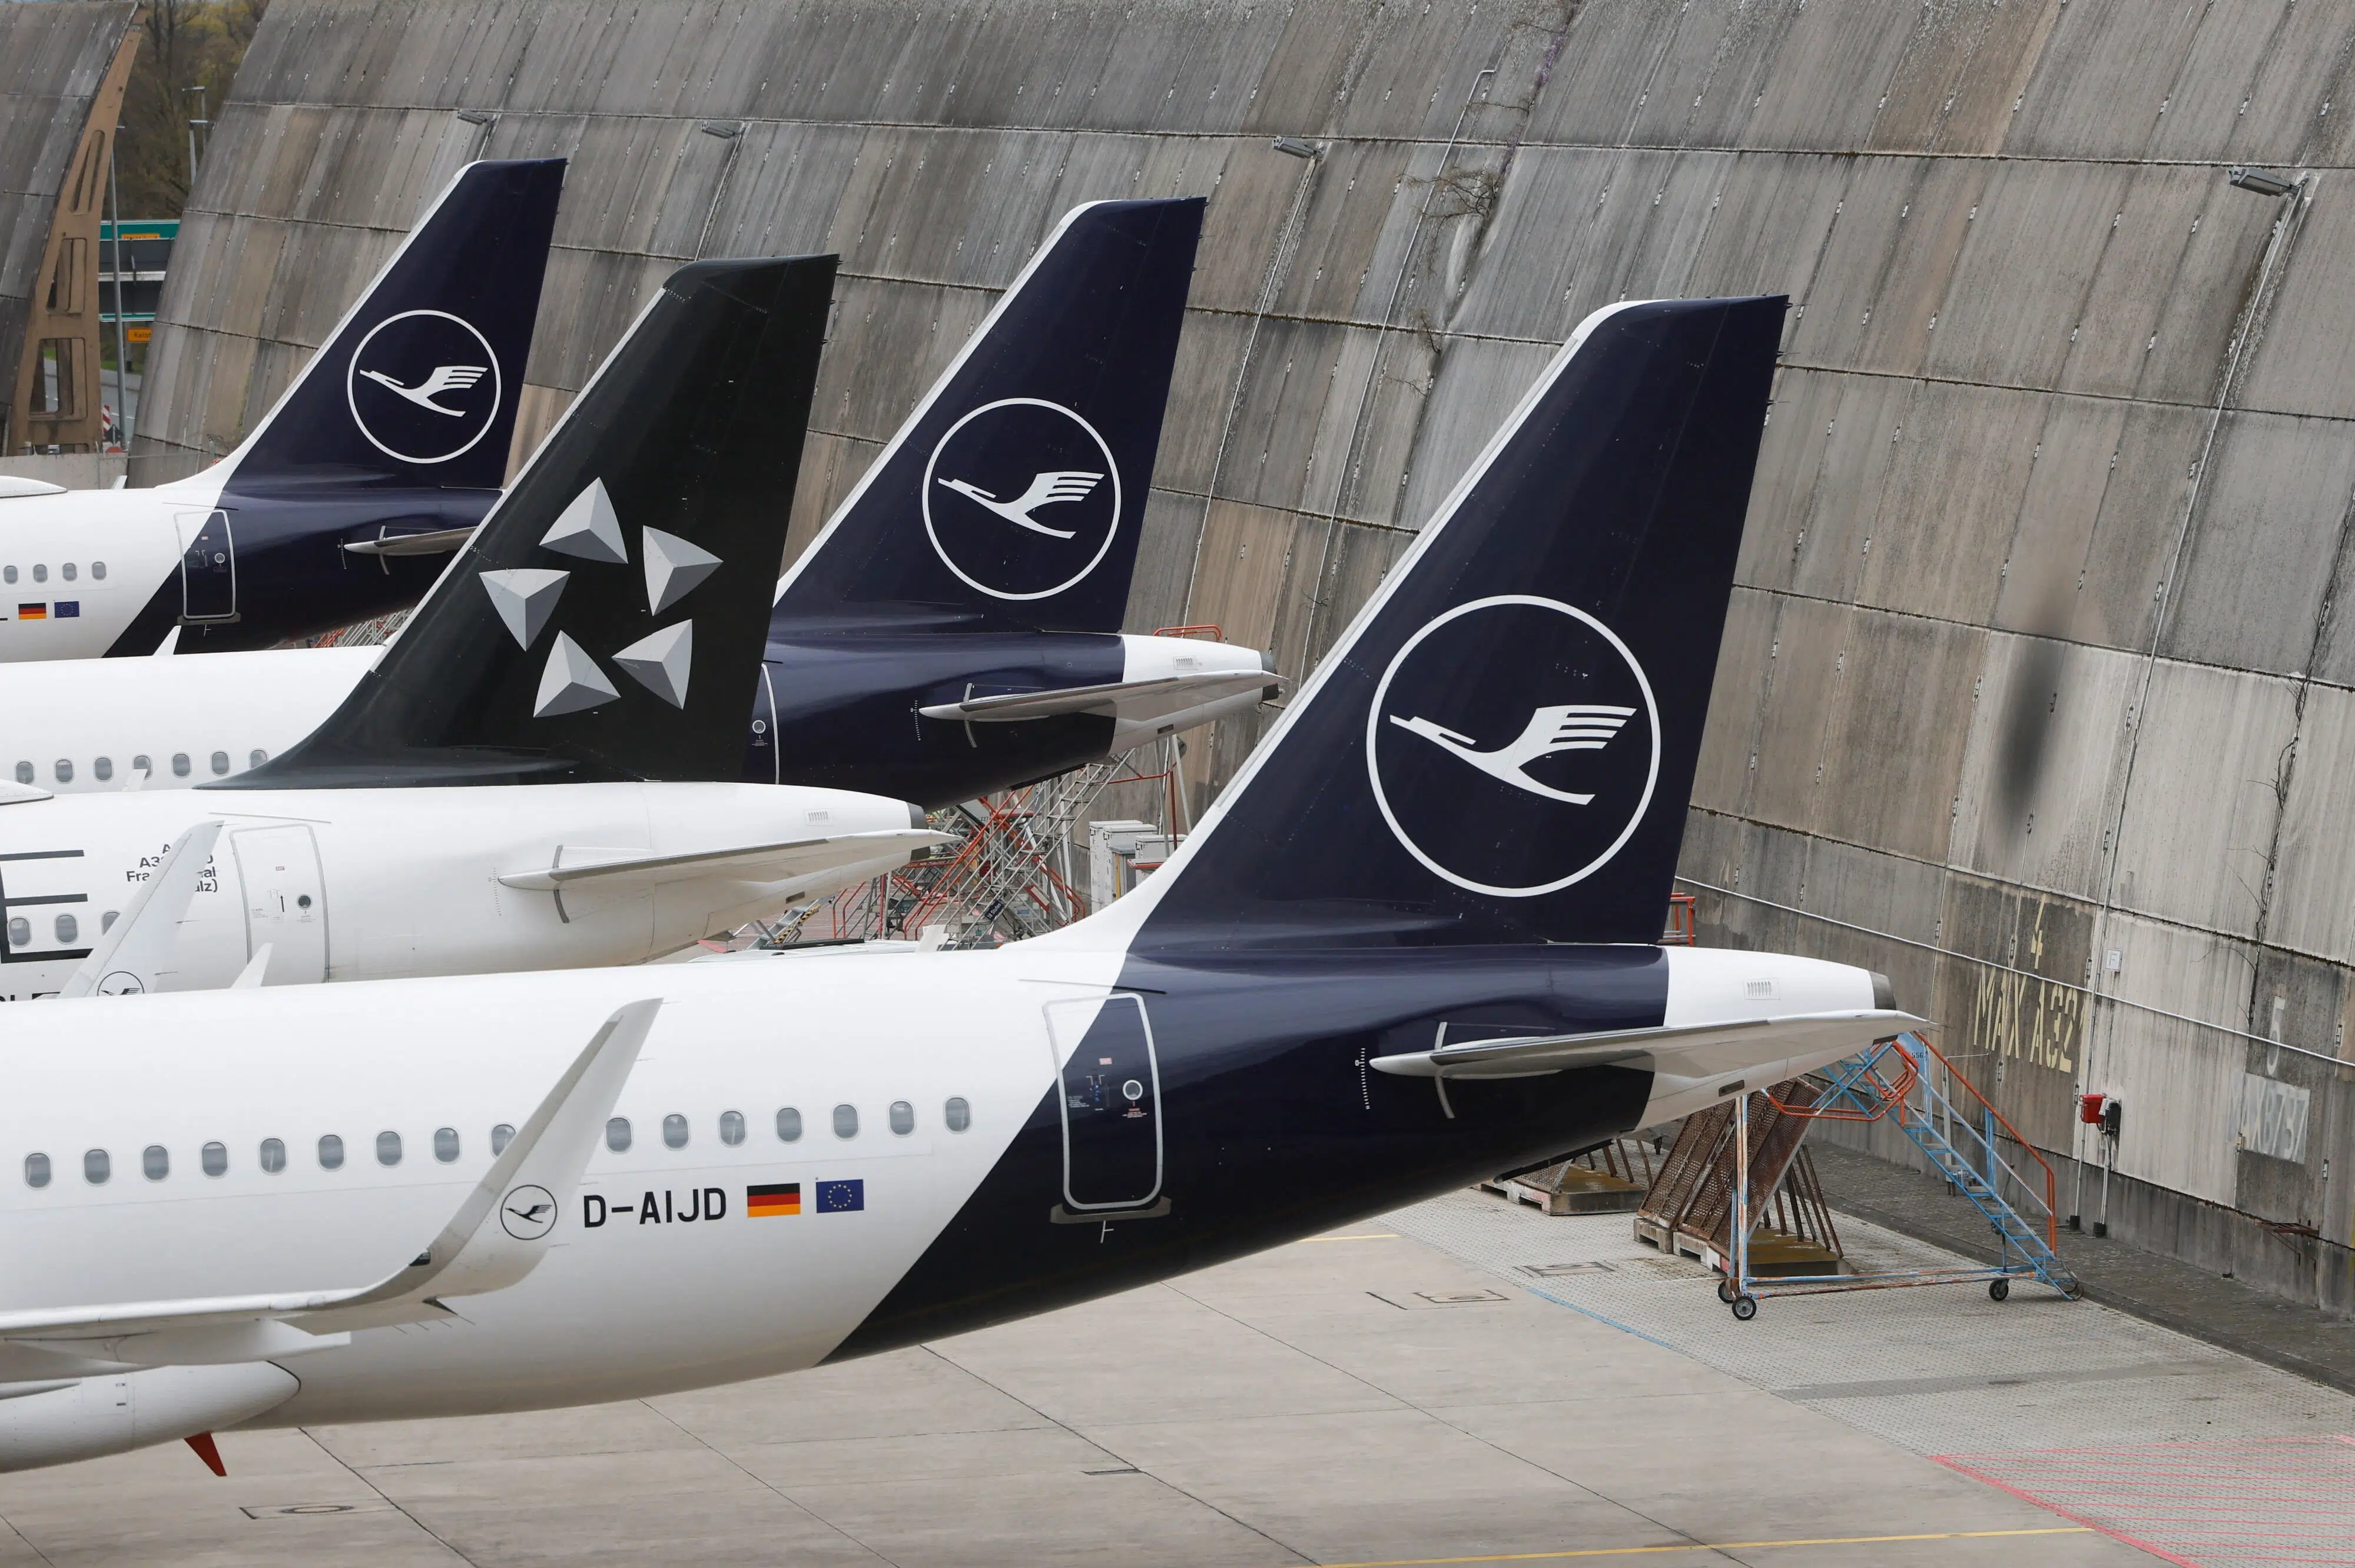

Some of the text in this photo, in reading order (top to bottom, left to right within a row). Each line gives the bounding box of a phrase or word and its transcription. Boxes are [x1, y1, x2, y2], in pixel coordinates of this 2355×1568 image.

[2031, 893, 2046, 969] 4
[1973, 962, 2027, 1059] MAX
[2267, 995, 2286, 1076] 5
[583, 1187, 727, 1228] D-AIJD
